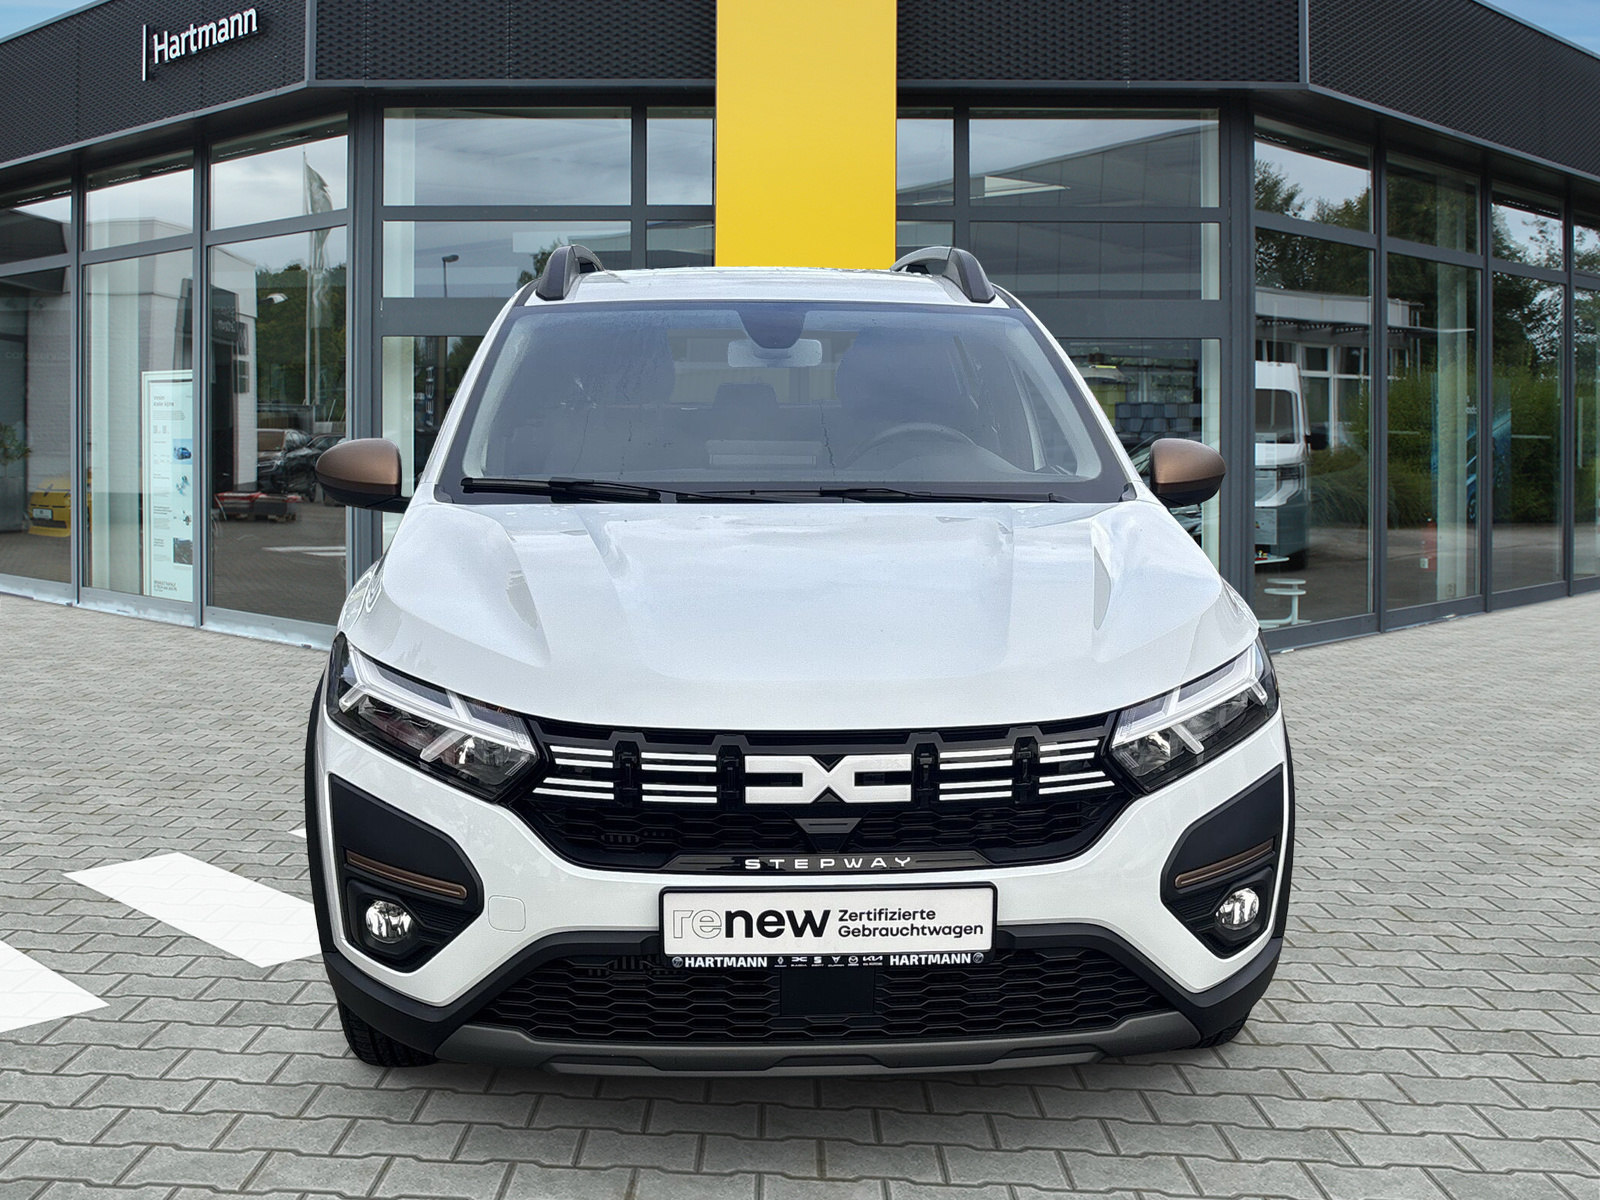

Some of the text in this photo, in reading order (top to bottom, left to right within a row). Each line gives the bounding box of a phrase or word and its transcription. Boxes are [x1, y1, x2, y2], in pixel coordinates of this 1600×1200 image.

[153, 8, 258, 64] Hartmann
[745, 856, 911, 870] STEPWAY
[838, 908, 936, 922] Zertifizierte
[673, 909, 831, 939] renew
[838, 924, 984, 939] Gebrauchtwagen
[684, 956, 768, 968] HARTMANN
[890, 953, 971, 966] HARTMANN
